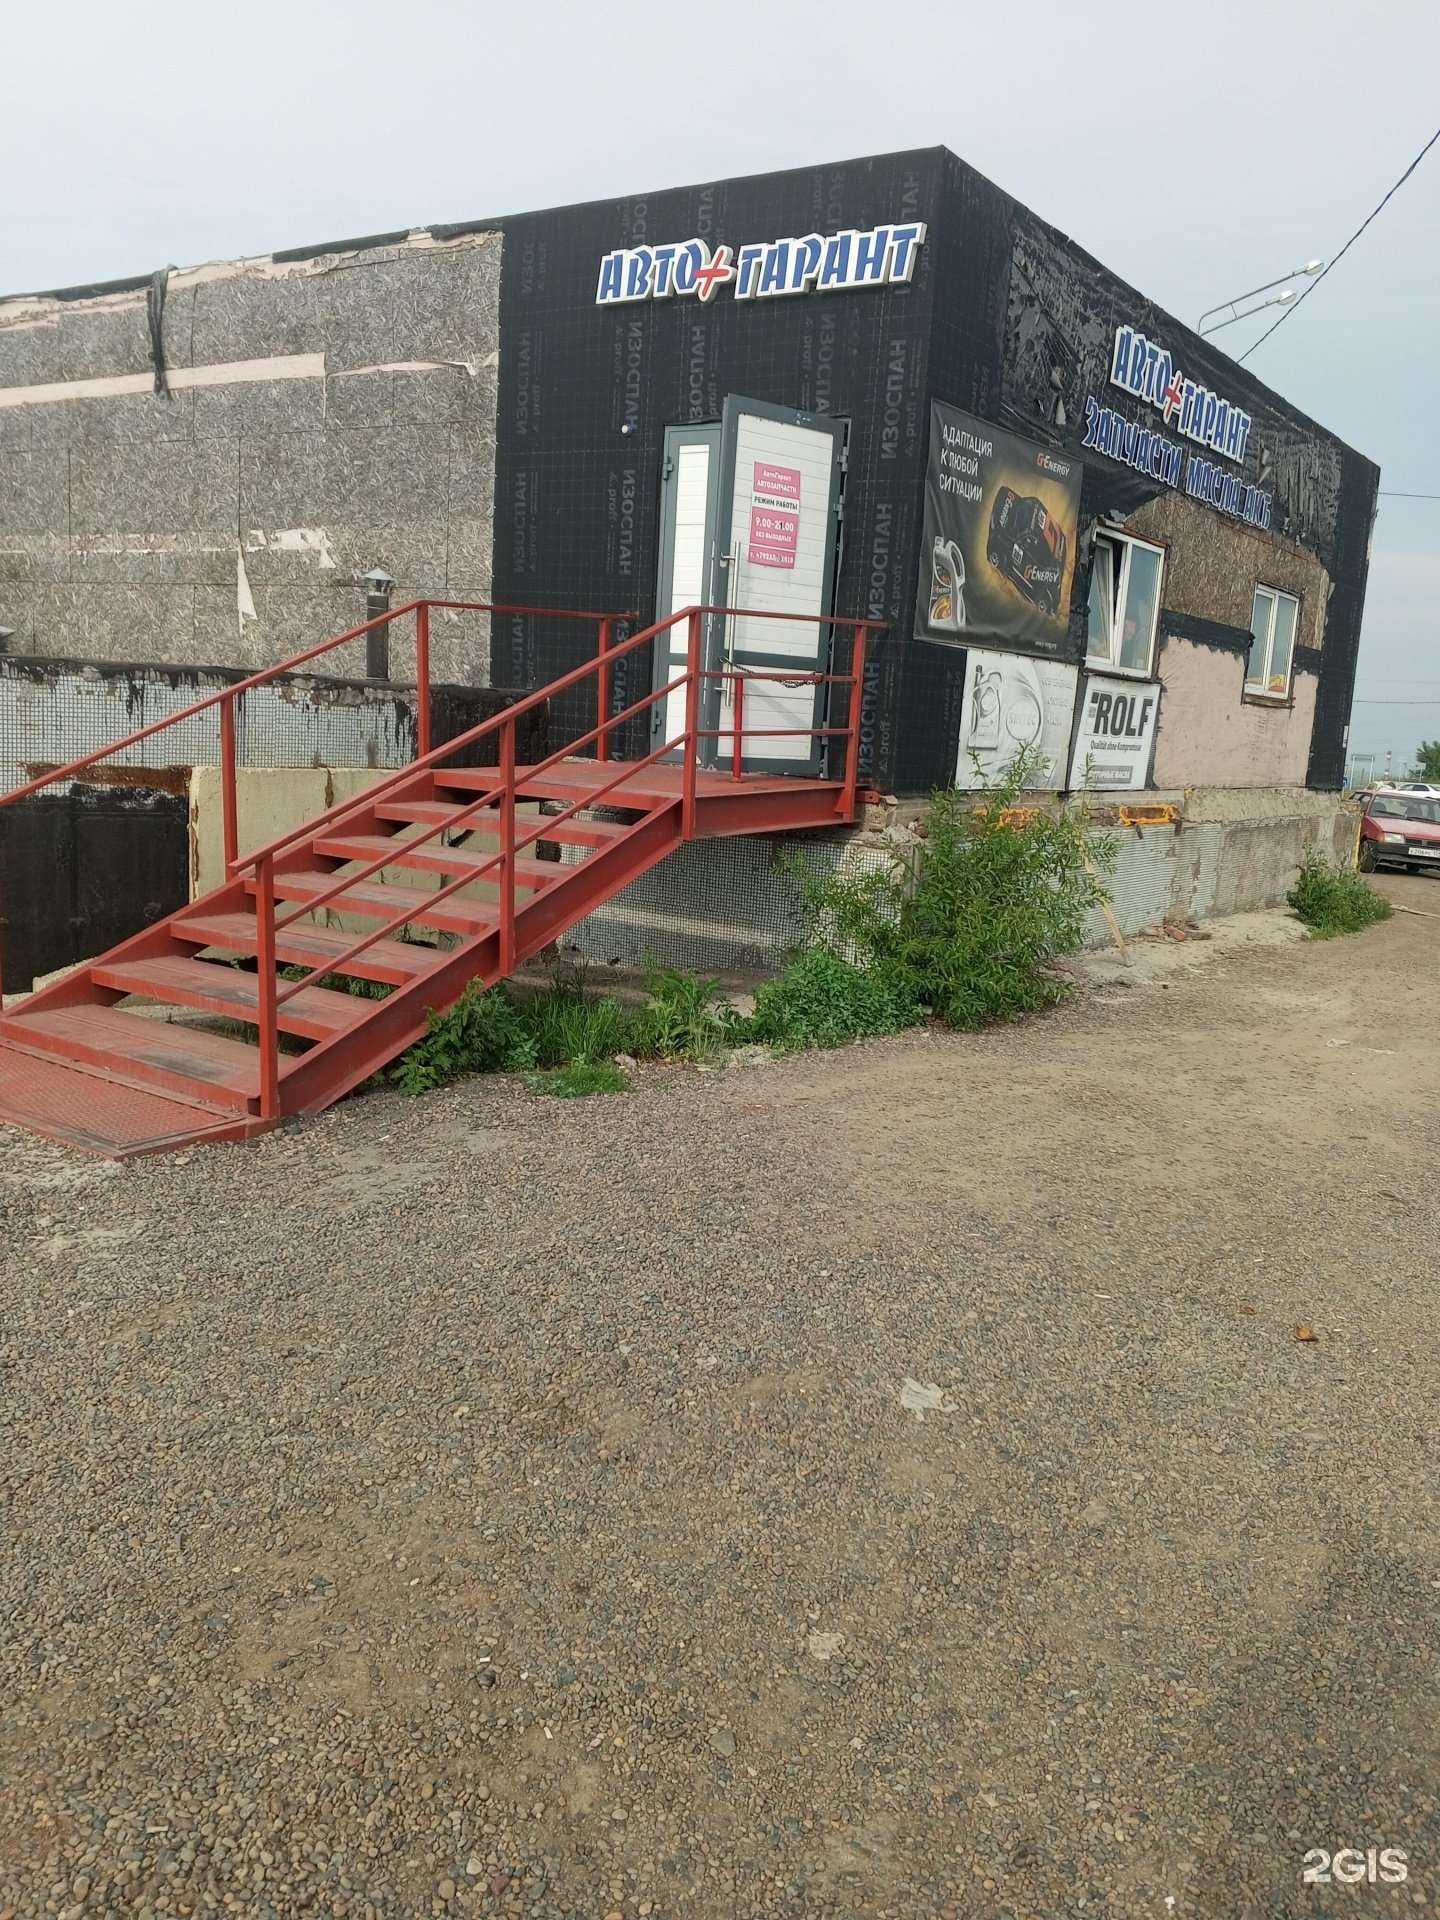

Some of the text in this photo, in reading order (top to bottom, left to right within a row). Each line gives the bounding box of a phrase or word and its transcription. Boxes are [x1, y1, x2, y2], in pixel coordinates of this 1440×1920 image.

[881, 339, 907, 459] ИЗОСПАН
[941, 448, 979, 477] К ЛЮБОЙ
[943, 424, 993, 458] АДАПТАЦИЯ
[1081, 396, 1182, 489] ЗАПЧАСТИ
[1186, 457, 1242, 516] МАСЛА
[618, 469, 636, 576] ИЗОСПАН
[776, 499, 798, 510] РАБОТЫ
[939, 473, 983, 503] СИТУАЦИИ
[867, 503, 893, 620] ИЗОСПАН
[858, 662, 881, 774] ИЗОСПАН
[1093, 694, 1153, 737] ROLF
